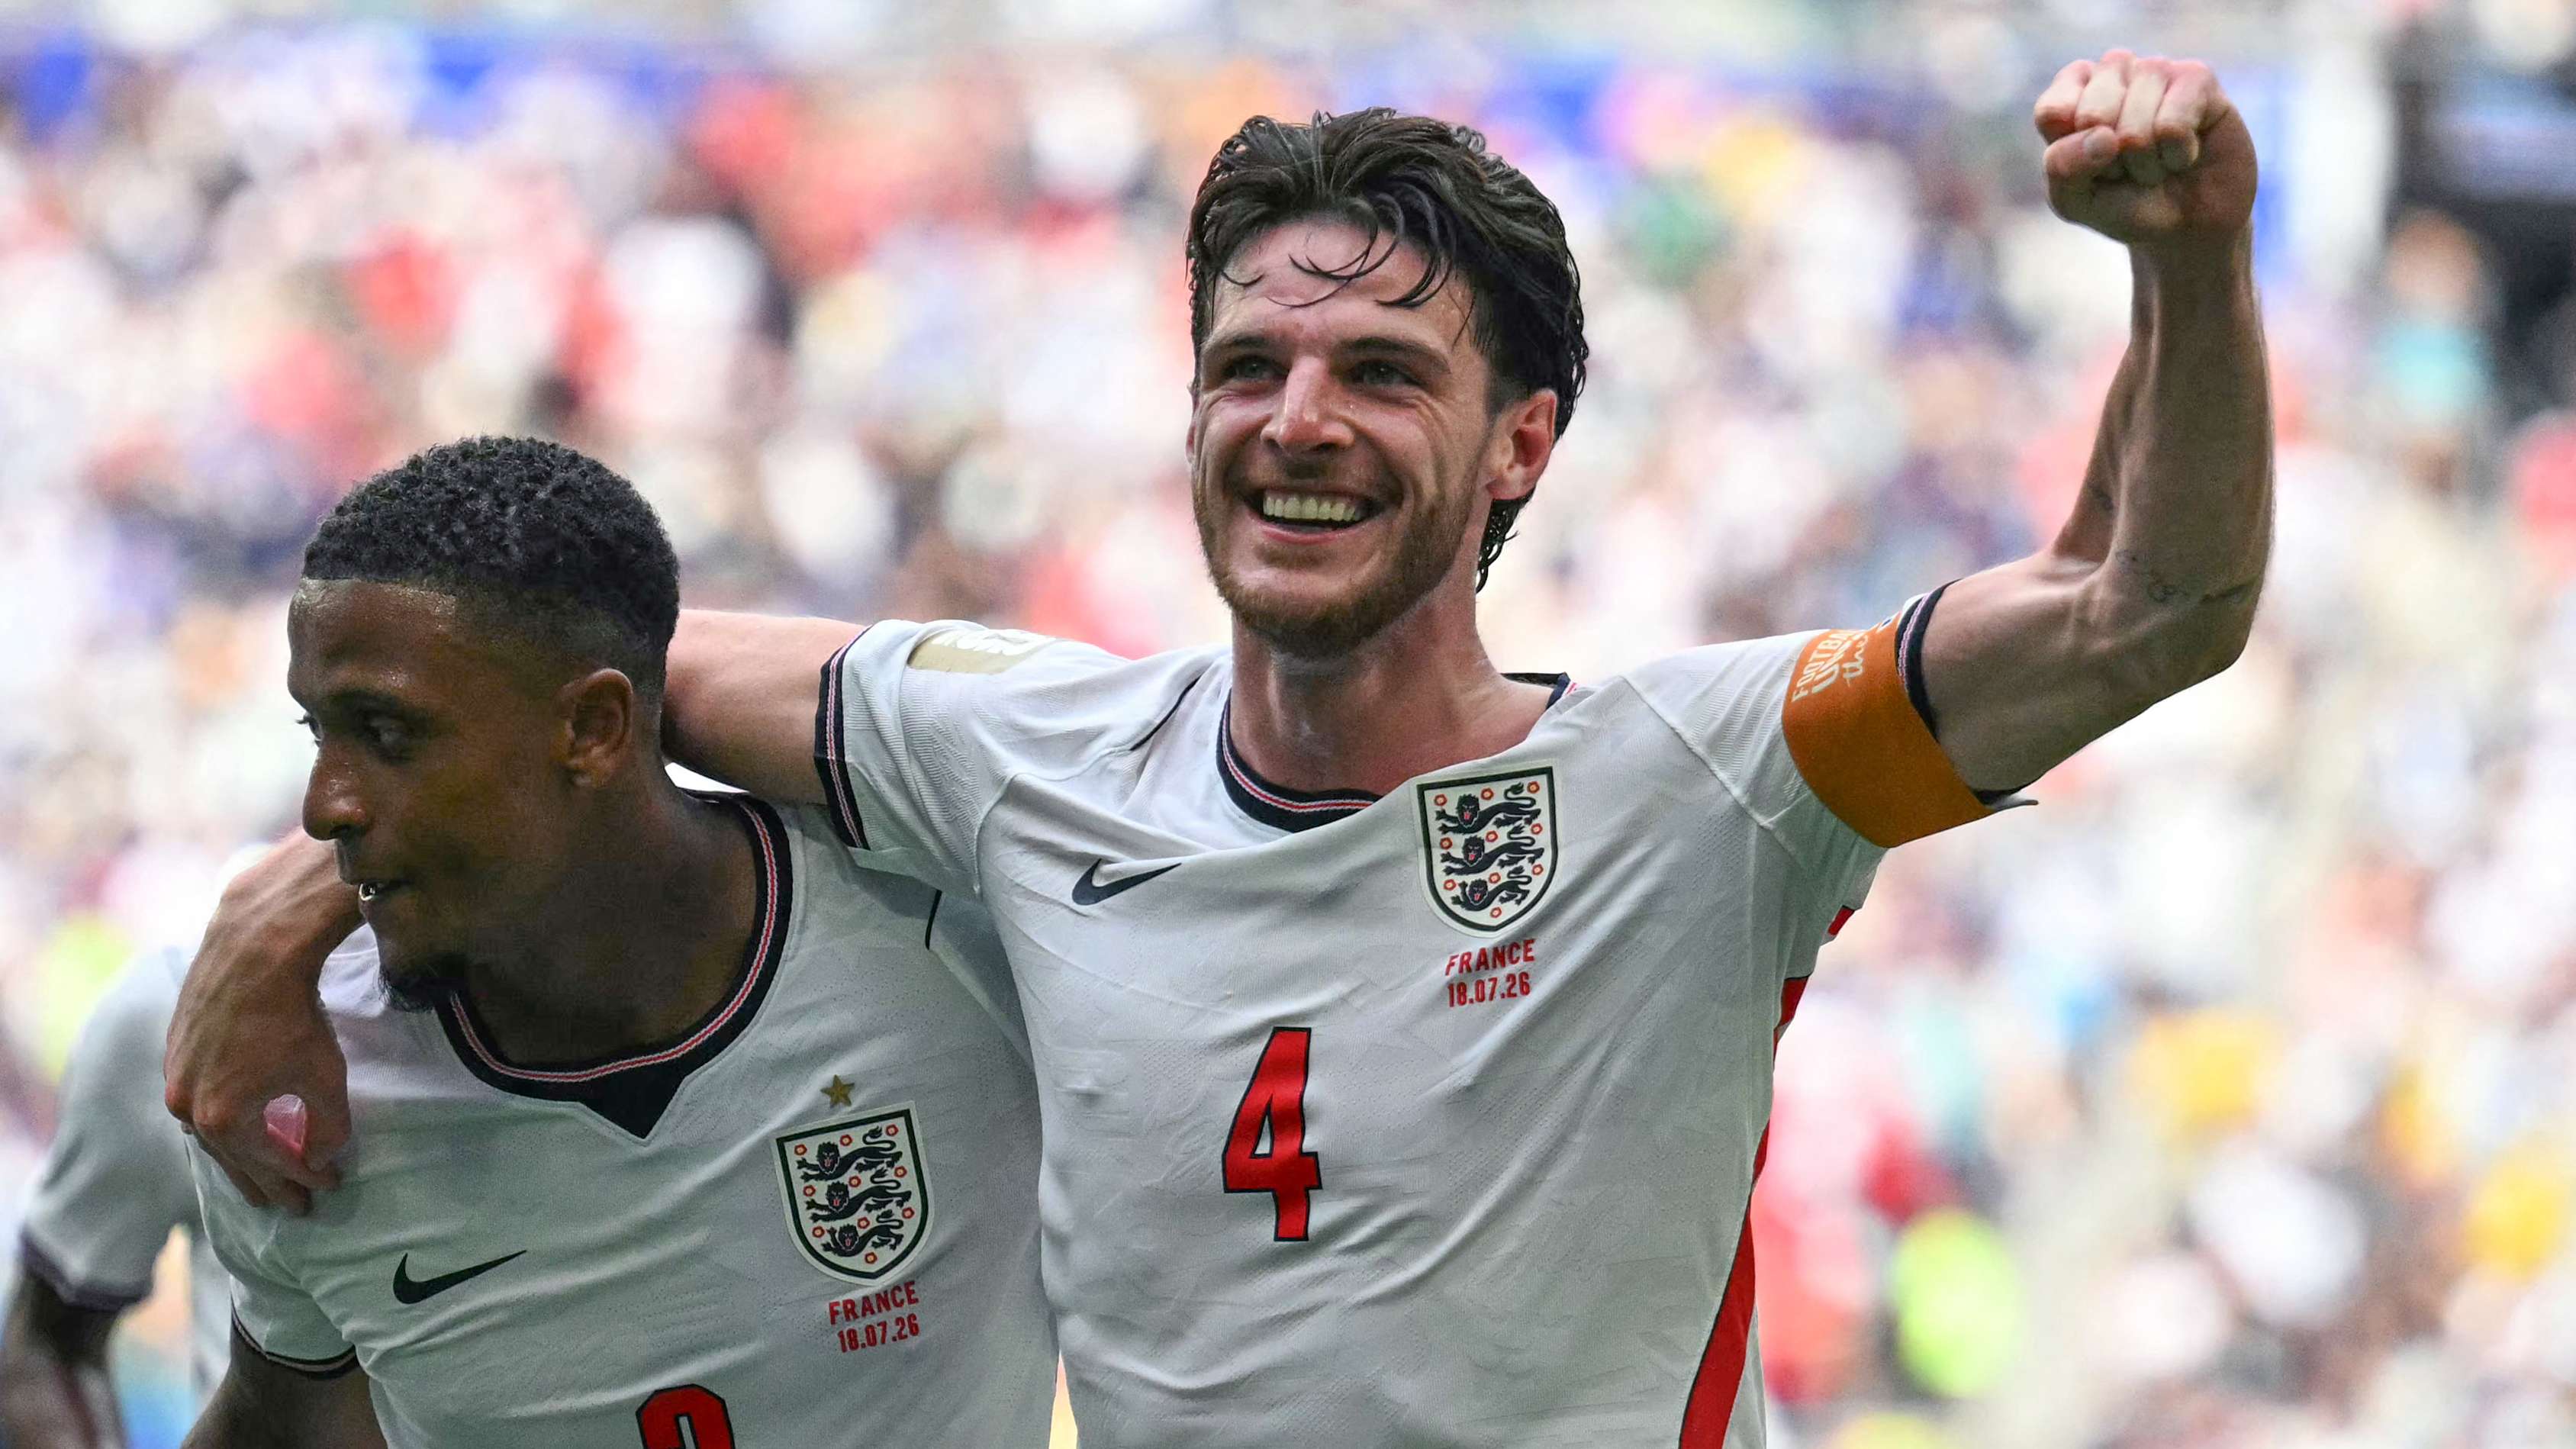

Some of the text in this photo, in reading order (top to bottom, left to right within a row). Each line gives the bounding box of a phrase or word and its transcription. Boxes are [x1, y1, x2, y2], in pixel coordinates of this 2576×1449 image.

[1791, 629, 1859, 702] FOOTBA
[1444, 938, 1536, 976] FRANCE
[1447, 971, 1531, 1008] 18.07.26
[1222, 1026, 1322, 1241] 4
[829, 1280, 919, 1325] FRANCE
[837, 1312, 920, 1353] 18.07.26
